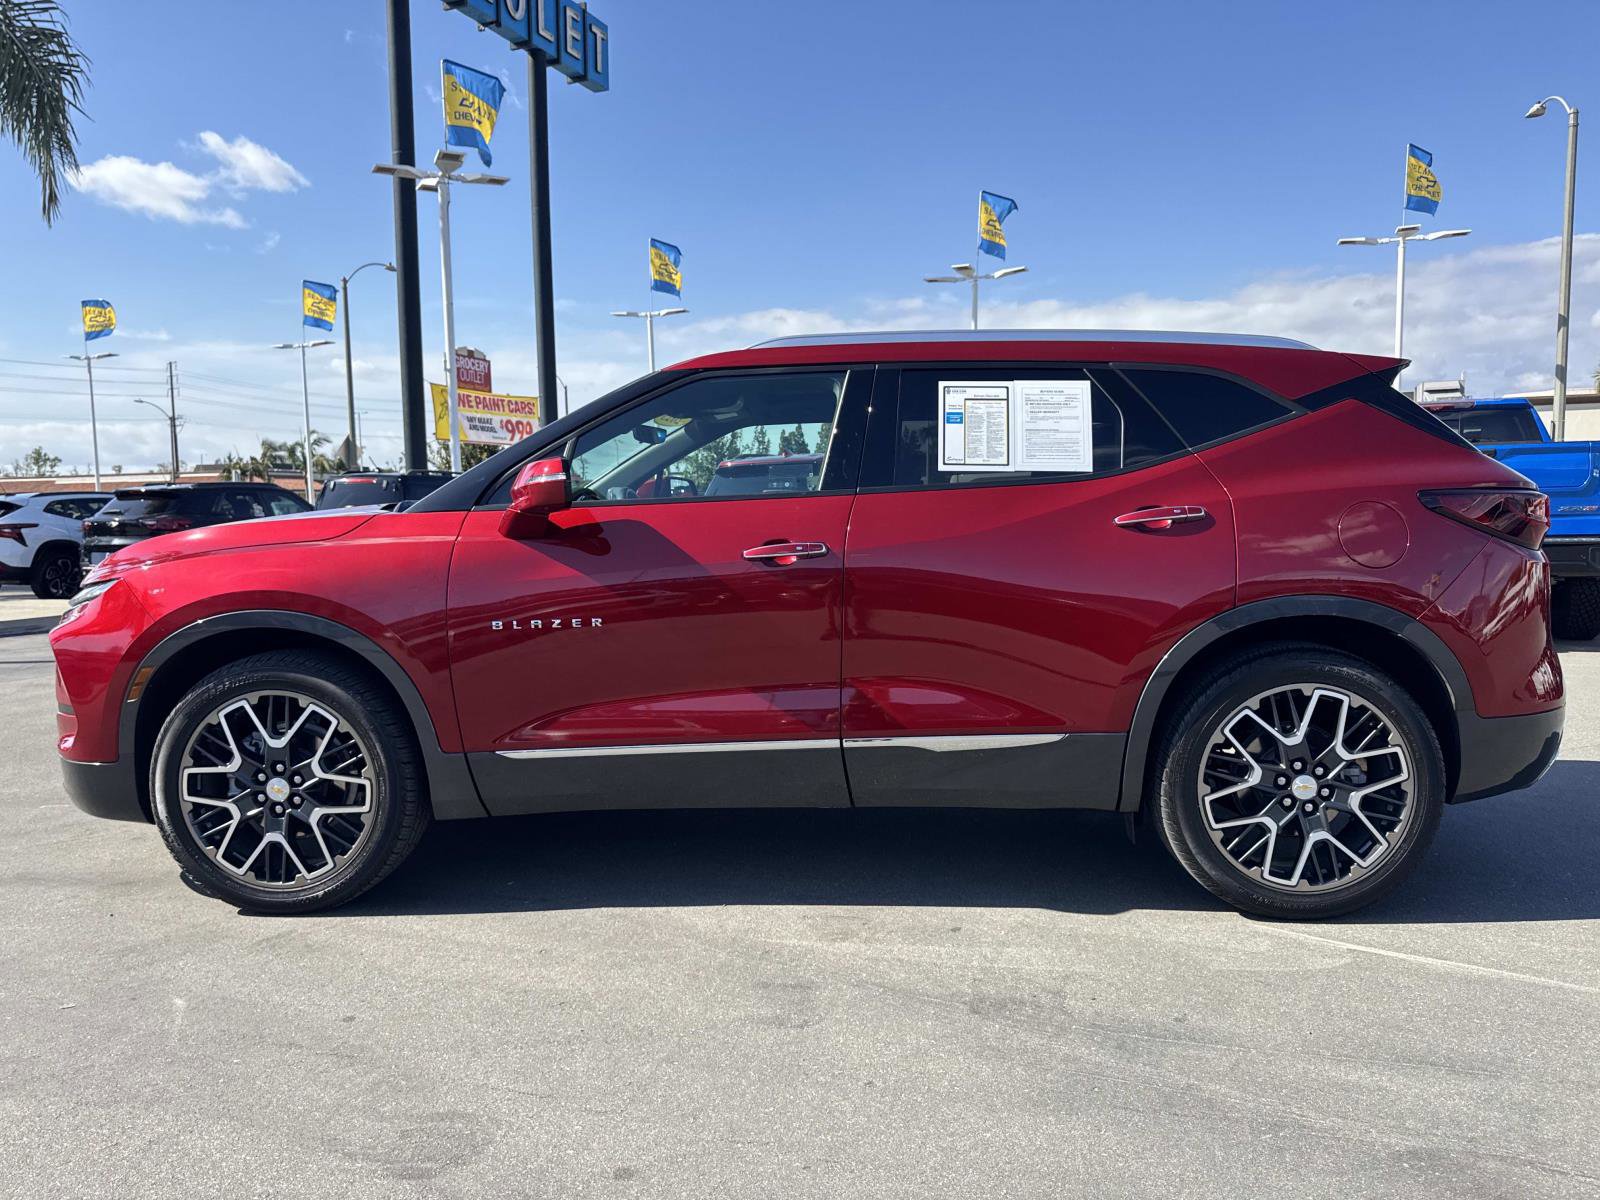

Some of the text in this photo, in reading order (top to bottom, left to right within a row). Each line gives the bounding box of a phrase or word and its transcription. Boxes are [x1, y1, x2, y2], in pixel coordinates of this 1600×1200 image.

[460, 369, 485, 384] OUTLET
[475, 395, 505, 412] PAINT
[507, 399, 535, 415] CARS!
[477, 417, 493, 425] MAKE
[491, 617, 603, 630] BLAZER
